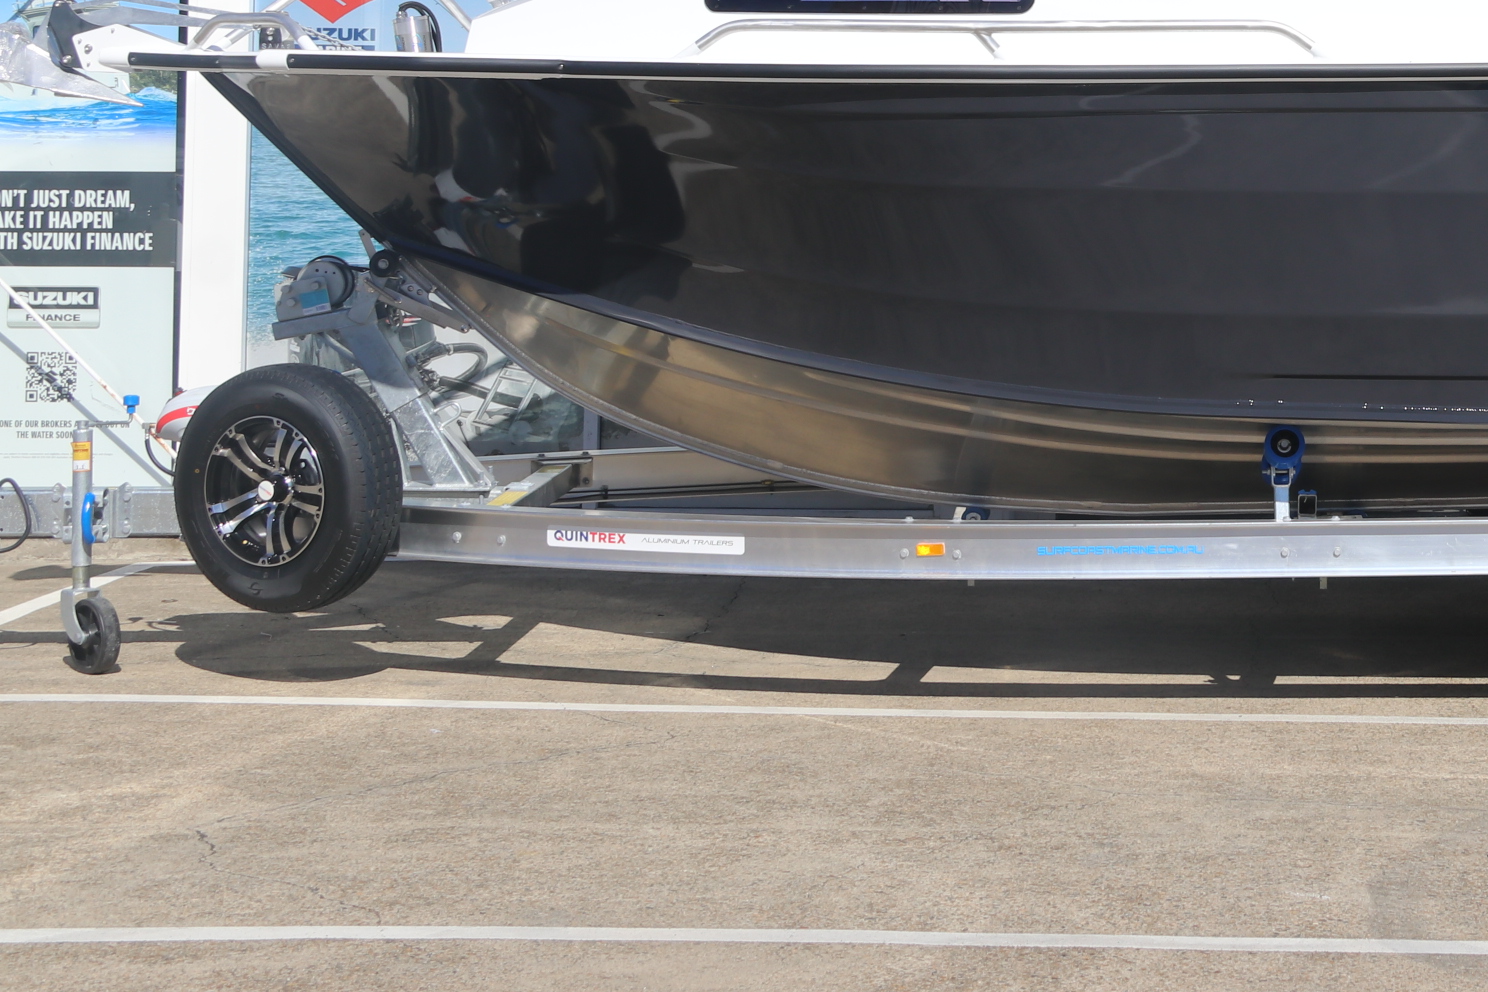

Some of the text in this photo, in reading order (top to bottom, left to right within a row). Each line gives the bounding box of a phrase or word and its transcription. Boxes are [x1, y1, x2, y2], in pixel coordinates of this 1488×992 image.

[0, 189, 136, 211] N'T JUST DREAM,
[28, 210, 44, 228] IT
[48, 210, 114, 229] HAPPEN
[22, 231, 82, 250] SUZUKI
[86, 232, 154, 250] FINANCE
[14, 419, 23, 428] OF
[25, 419, 39, 428] OUR
[41, 419, 73, 428] BROKERS
[16, 430, 29, 439] THE
[31, 430, 54, 439] WATER
[553, 529, 627, 544] QUINTREX
[641, 537, 690, 545] ALUMINIUM
